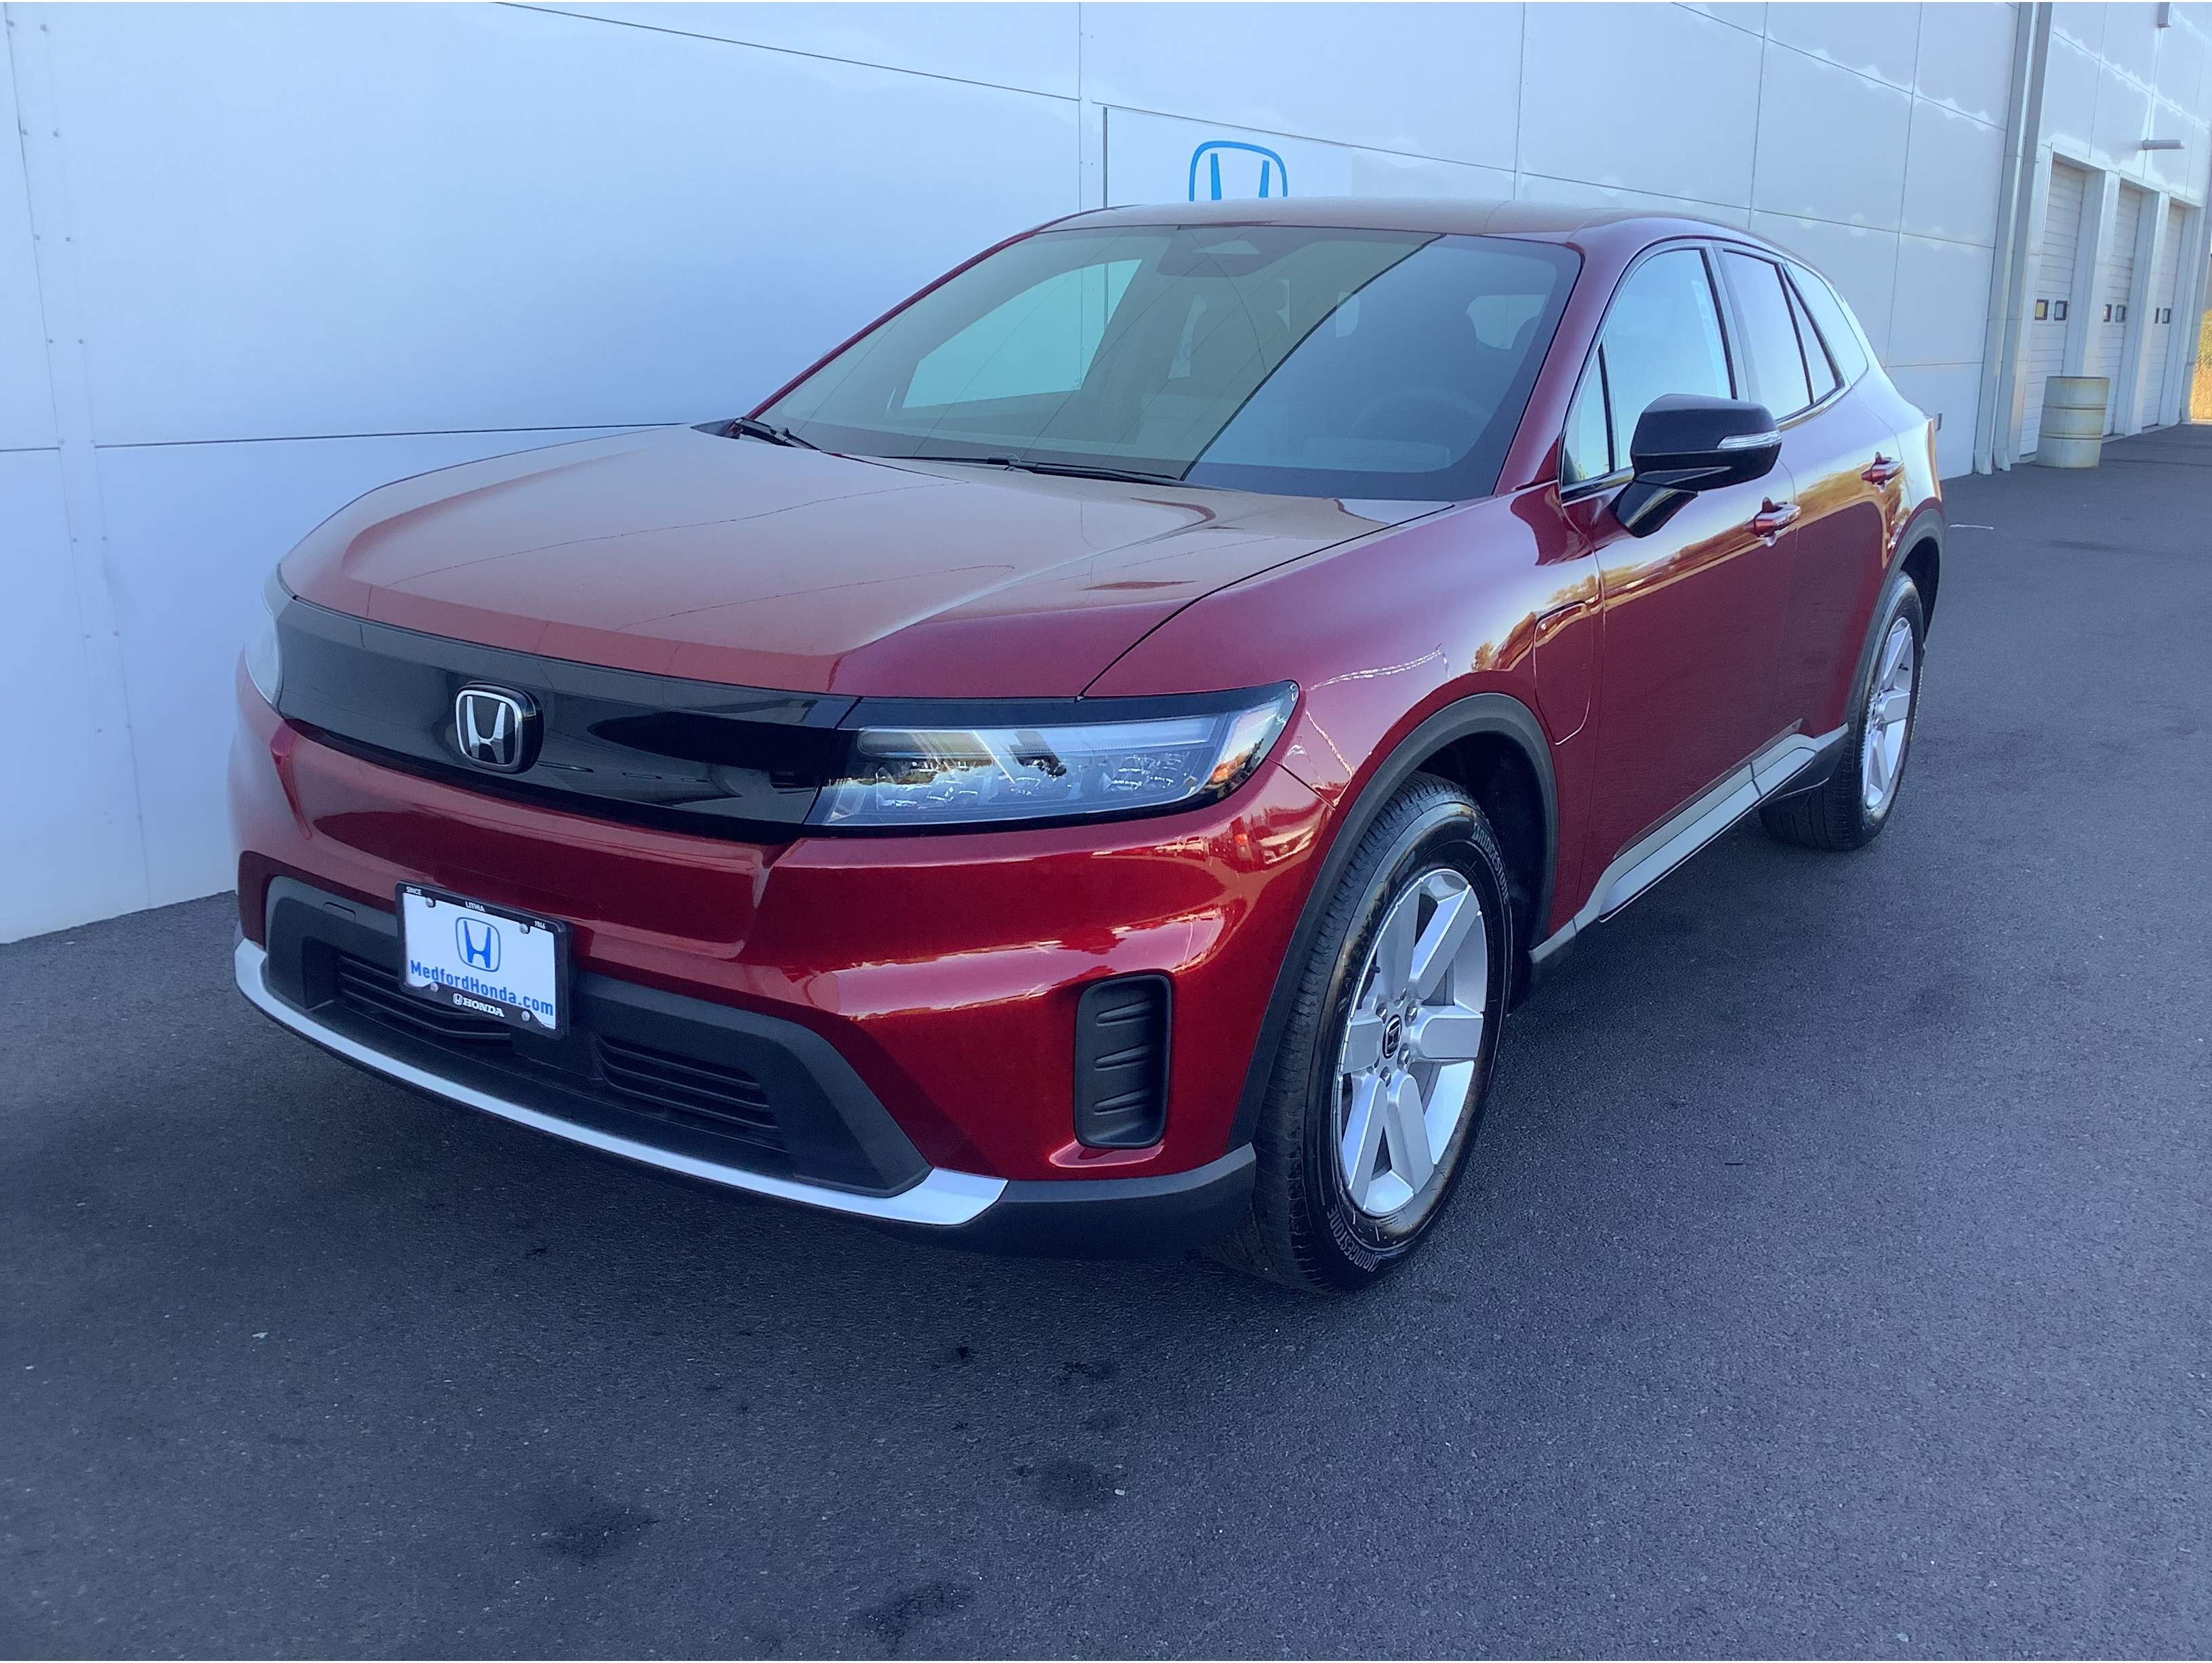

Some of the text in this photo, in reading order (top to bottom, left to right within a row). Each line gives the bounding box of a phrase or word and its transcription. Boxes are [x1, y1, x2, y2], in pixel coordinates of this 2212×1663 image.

[1471, 823, 1509, 905] BRIDGESTONE
[407, 886, 422, 895] SINCE
[465, 901, 485, 913] LITHIA
[411, 960, 553, 1016] MedfordHonda.com
[463, 998, 505, 1017] HONDA
[1327, 1204, 1382, 1272] BRIDGESTONE
